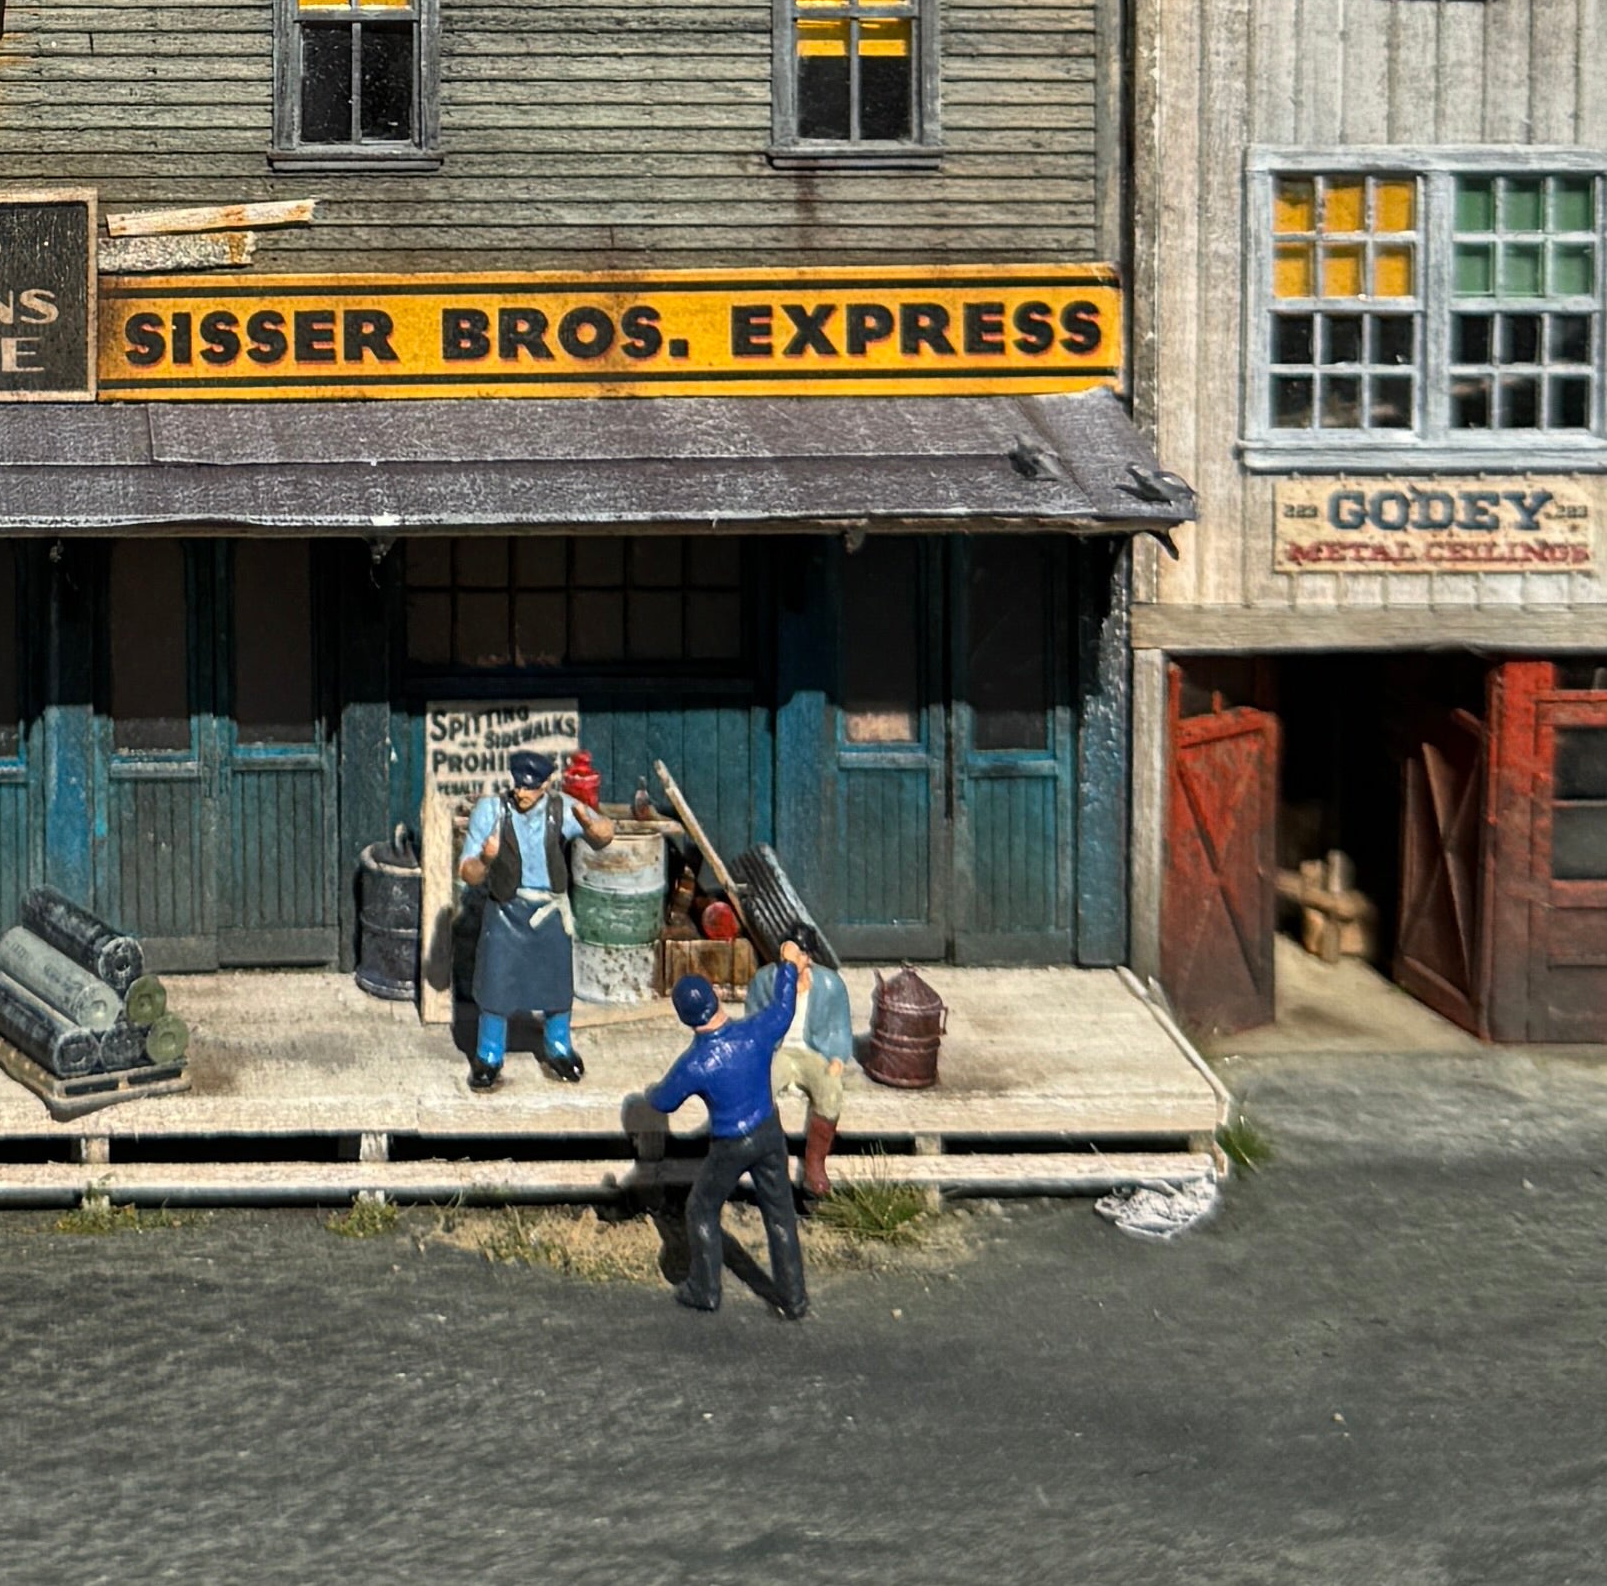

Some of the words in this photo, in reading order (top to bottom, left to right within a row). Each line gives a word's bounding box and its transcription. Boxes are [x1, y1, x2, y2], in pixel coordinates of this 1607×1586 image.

[123, 307, 400, 367] SISSER
[441, 304, 692, 365] BROS.
[730, 299, 1105, 358] EXPRESS
[1326, 489, 1554, 531] GODEY
[1285, 540, 1417, 565] METAL
[1422, 539, 1591, 565] CEILINGS
[430, 705, 530, 742] SPITTING
[483, 714, 578, 749] SIDEWALKS
